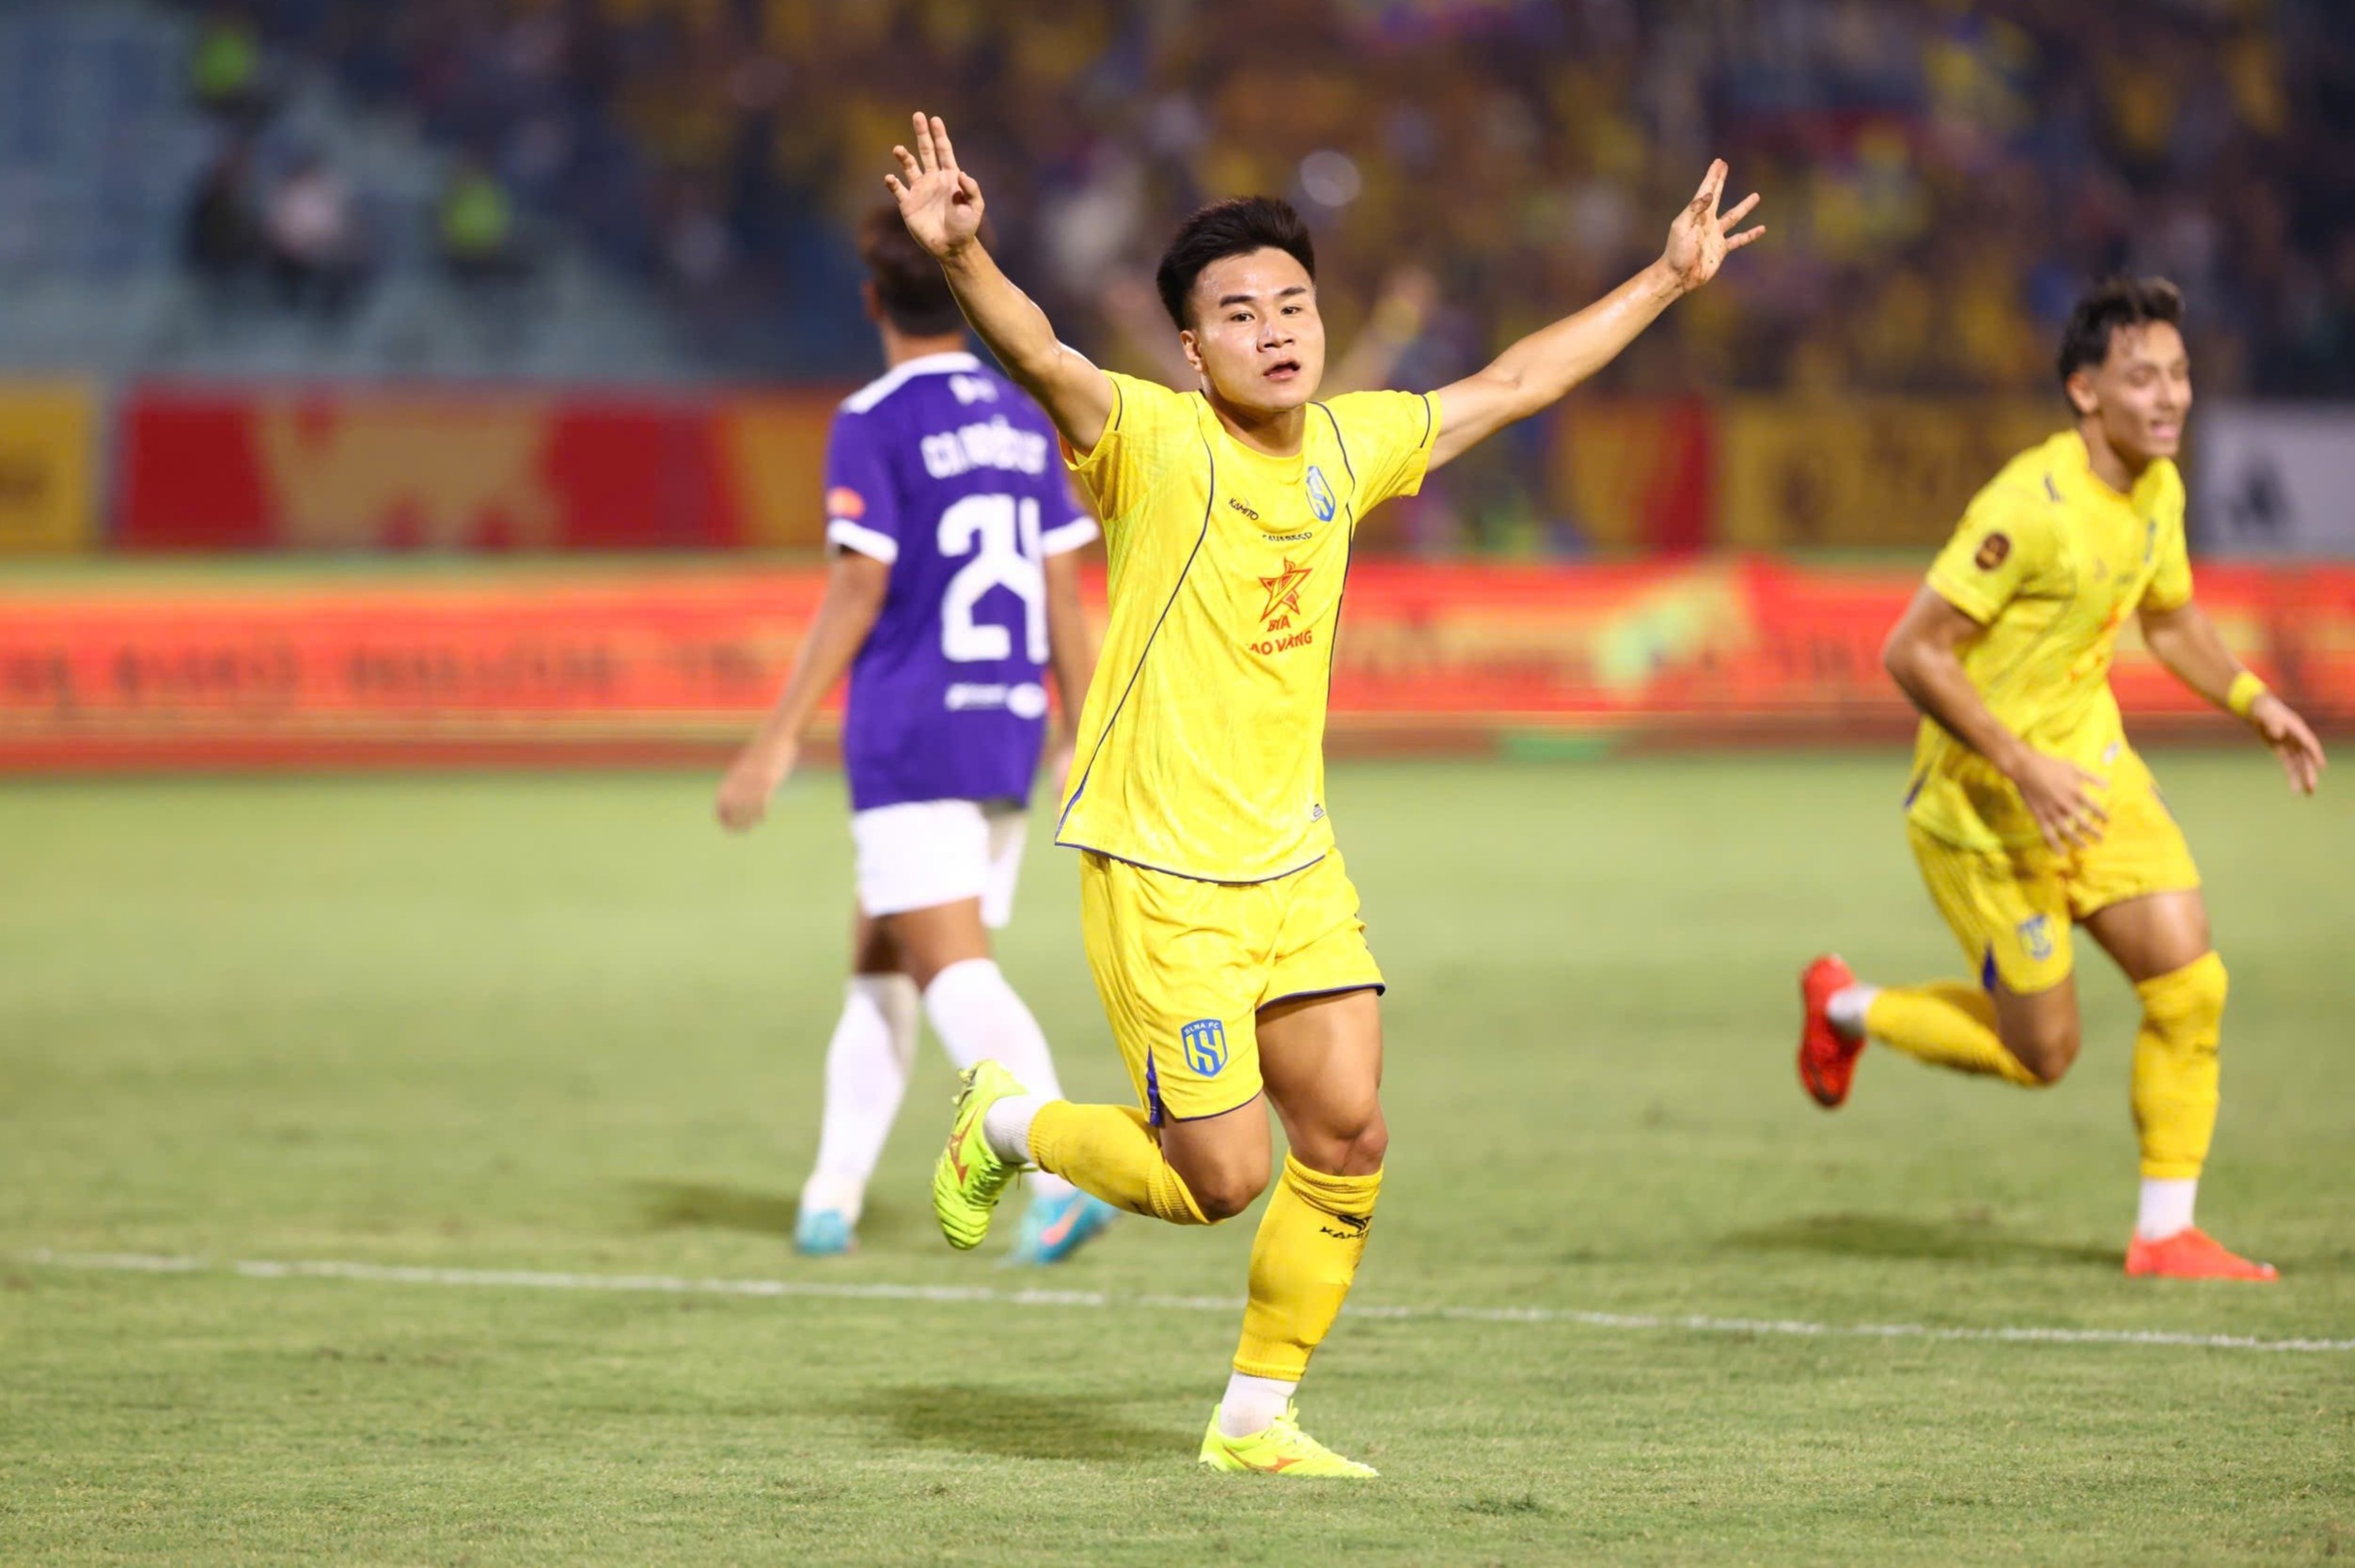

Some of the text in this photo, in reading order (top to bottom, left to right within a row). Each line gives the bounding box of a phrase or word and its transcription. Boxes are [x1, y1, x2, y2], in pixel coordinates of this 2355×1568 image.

[1229, 497, 1259, 521] KAMITO
[937, 493, 1050, 664] 24
[1246, 641, 1273, 655] AO
